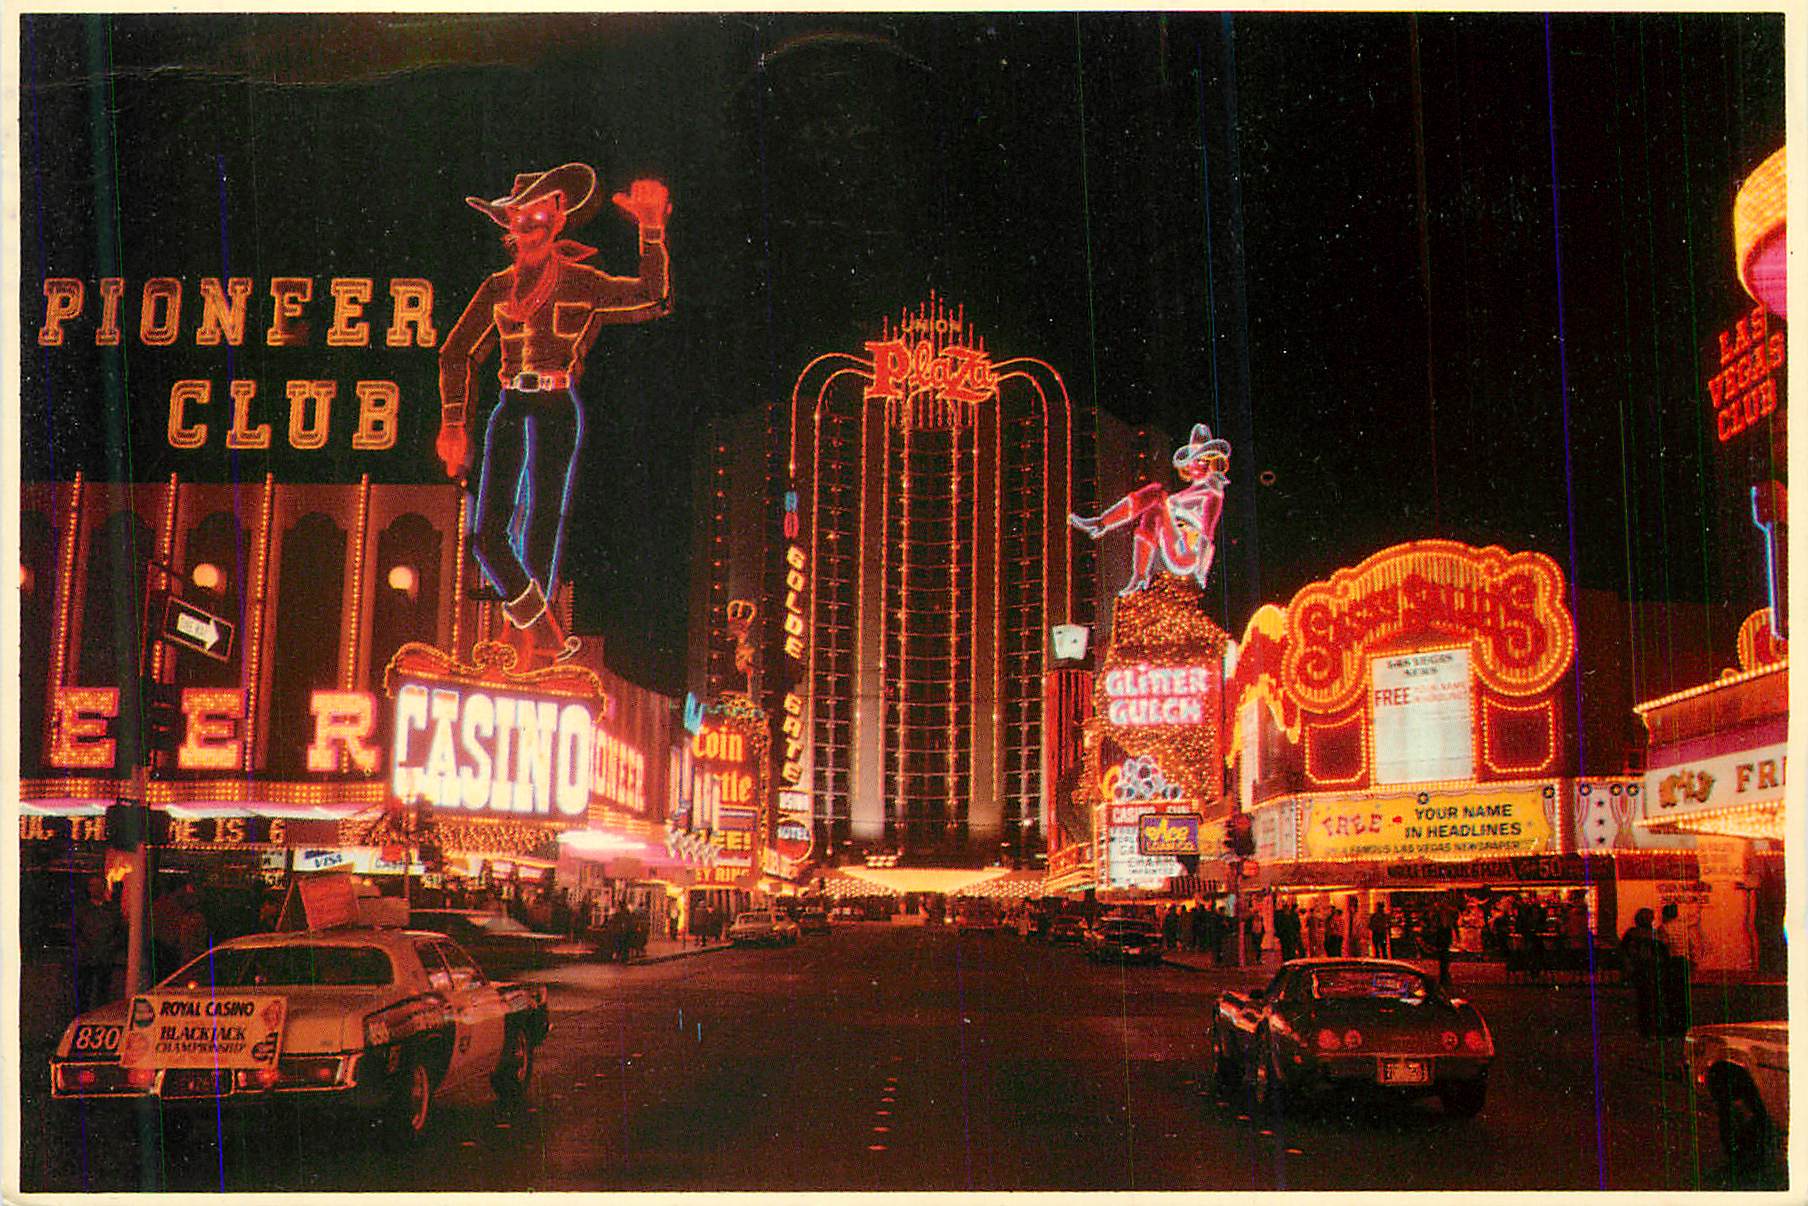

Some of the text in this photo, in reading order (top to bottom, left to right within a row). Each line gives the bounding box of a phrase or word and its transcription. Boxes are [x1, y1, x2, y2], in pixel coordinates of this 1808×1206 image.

[1718, 303, 1767, 366] LAS
[864, 338, 999, 403] Plaza
[1708, 330, 1785, 409] VEGAS
[167, 379, 399, 450] CLUB
[1717, 377, 1777, 443] CLUB
[784, 543, 806, 660] GOLDE
[1108, 698, 1204, 725] GULCH
[1374, 686, 1410, 707] FREE
[392, 683, 593, 817] CASINO
[782, 690, 804, 784] GATE
[214, 817, 245, 843] IS
[270, 818, 288, 845] 6
[1405, 822, 1523, 839] IN HEADLINES
[1414, 803, 1513, 821] YOUR NAME
[159, 1000, 255, 1017] ROYAL CASINO
[75, 1026, 121, 1050] 830
[155, 1041, 247, 1054] CHAMPIONSHIP
